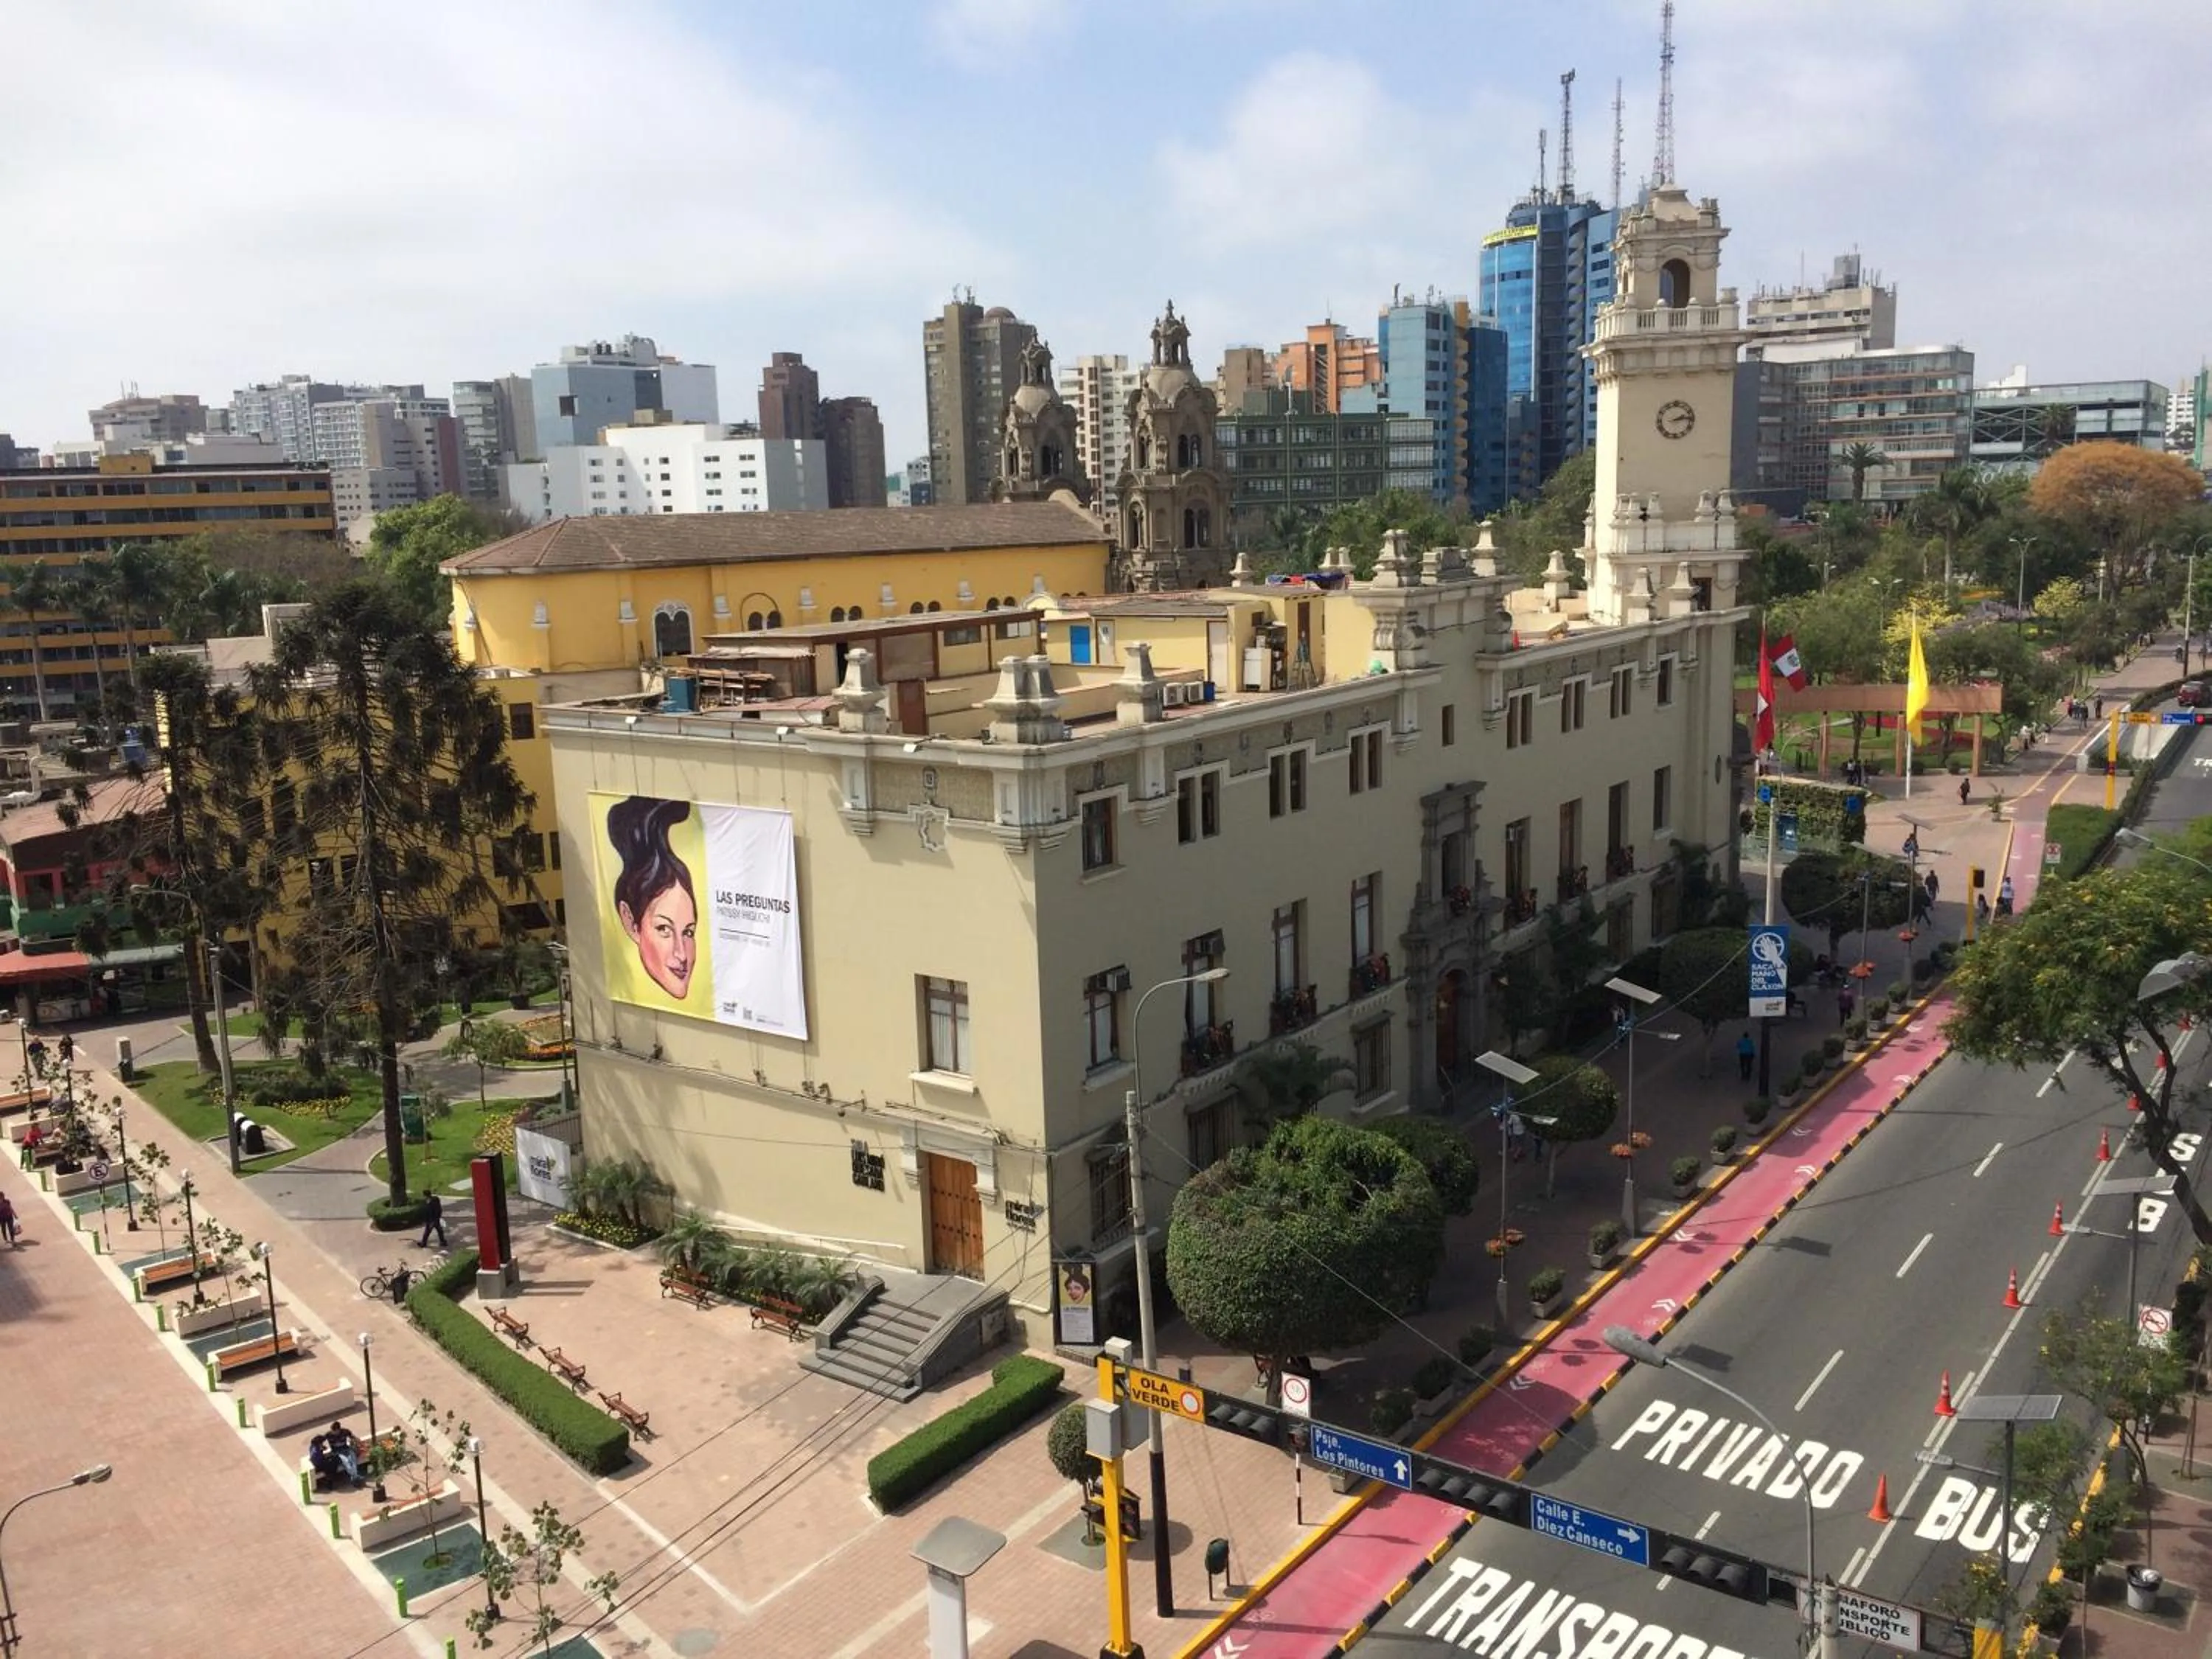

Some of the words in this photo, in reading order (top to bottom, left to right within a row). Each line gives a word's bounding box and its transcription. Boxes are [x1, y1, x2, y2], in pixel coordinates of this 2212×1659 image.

[716, 891, 732, 904] LAS
[736, 893, 790, 914] PREGUNTAS
[1132, 1388, 1180, 1411] VERDE
[1141, 1377, 1169, 1395] OLA
[1315, 1429, 1341, 1449] Psje.
[1316, 1445, 1335, 1462] Los
[1337, 1451, 1385, 1478] Pintores
[1611, 1399, 1865, 1509] PRIVADO
[1537, 1499, 1568, 1521] Calle
[1572, 1510, 1585, 1527] E.
[1914, 1476, 2051, 1562] BUS
[1537, 1516, 1565, 1537] Diez
[1567, 1526, 1624, 1555] Canseco
